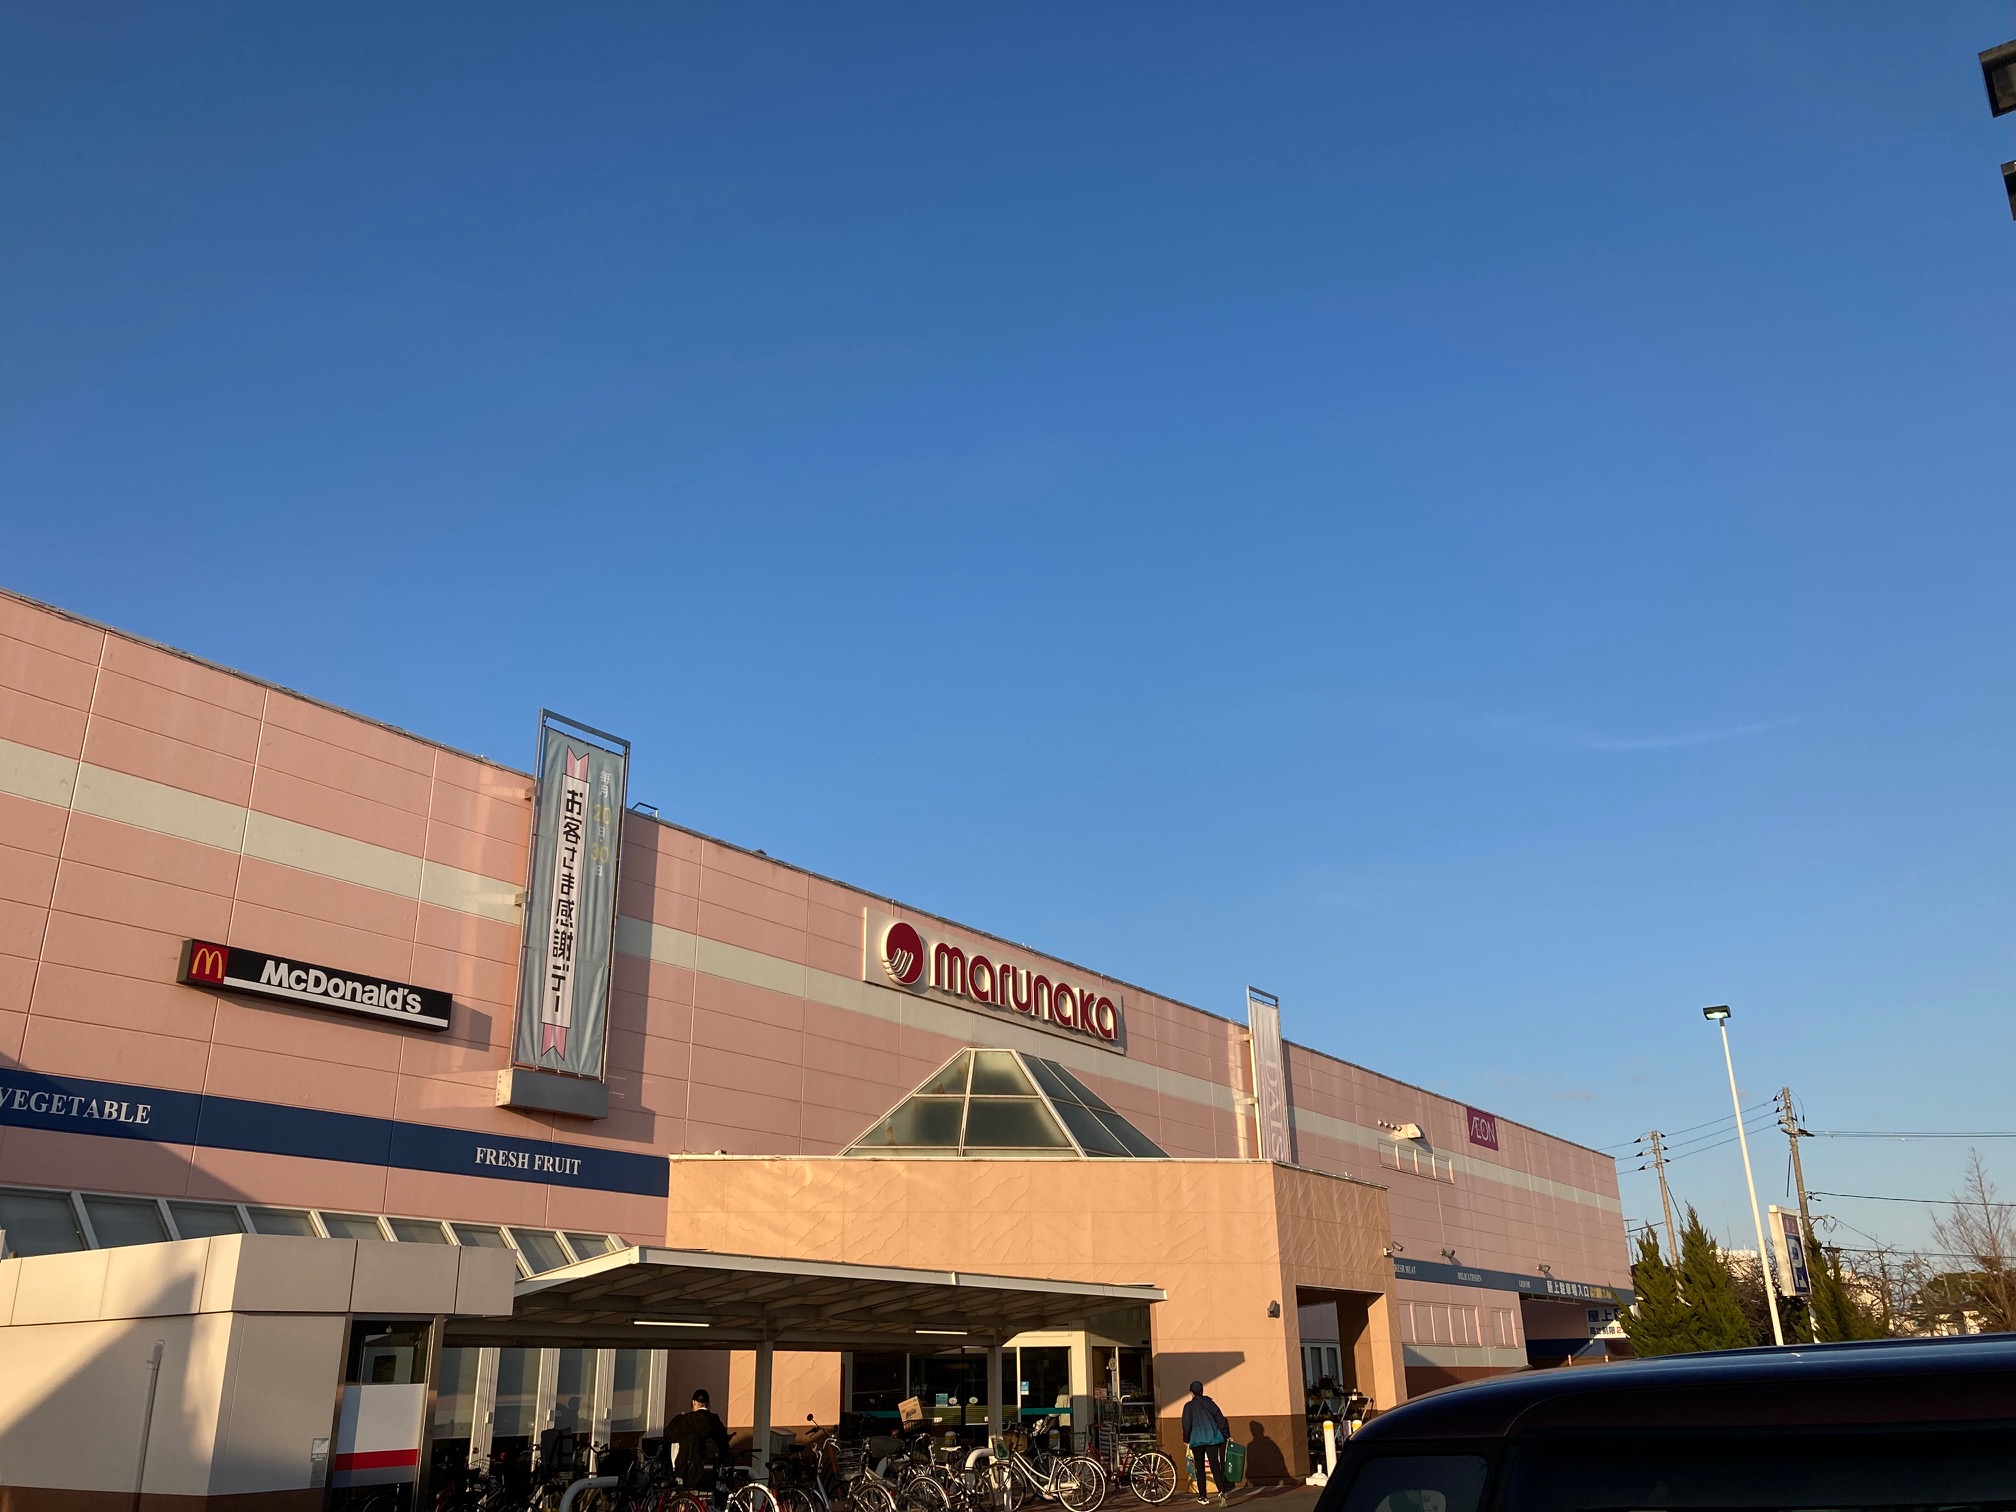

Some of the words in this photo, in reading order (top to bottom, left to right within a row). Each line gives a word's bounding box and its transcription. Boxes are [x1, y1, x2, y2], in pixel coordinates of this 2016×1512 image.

[550, 788, 584, 1013] お客さま感謝デー
[259, 959, 422, 1014] McDonald's
[930, 941, 1119, 1040] marunaka
[0, 1086, 152, 1124] VEGETABLE
[474, 1146, 530, 1170] FRESH
[533, 1154, 581, 1176] FRUIT
